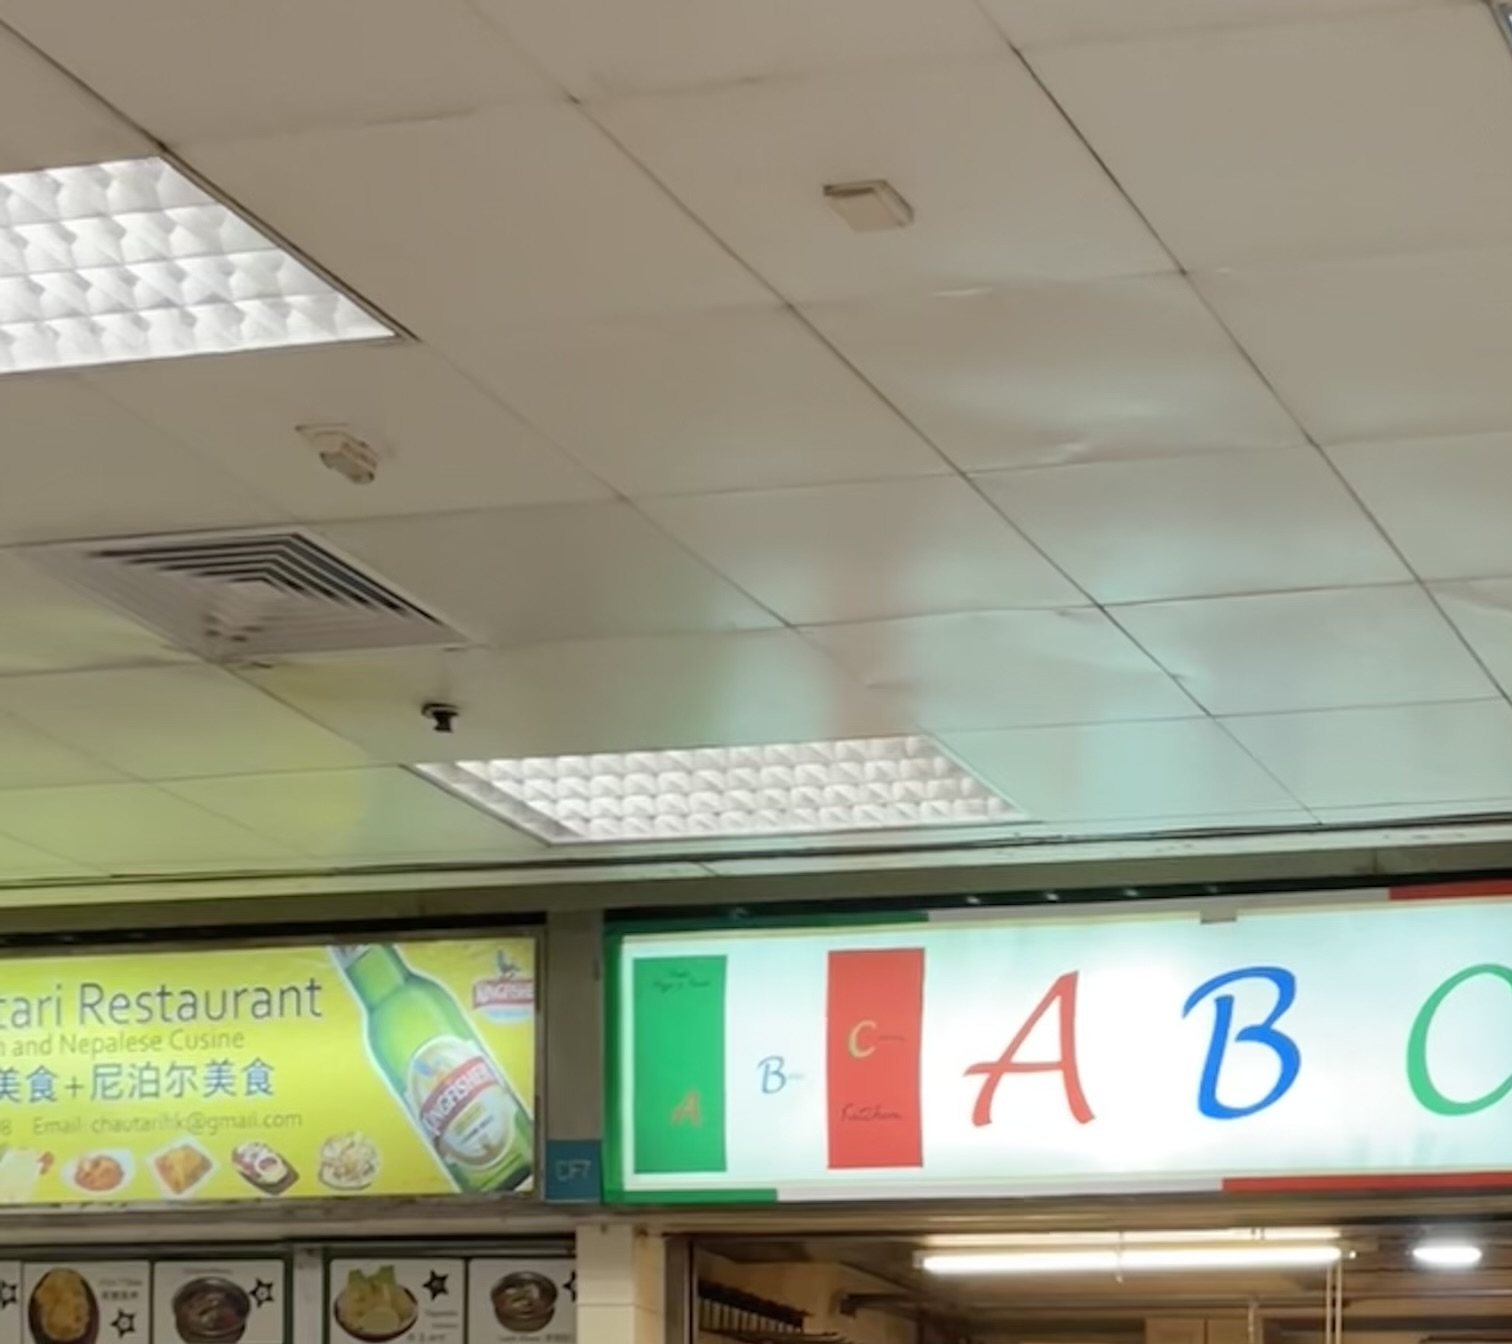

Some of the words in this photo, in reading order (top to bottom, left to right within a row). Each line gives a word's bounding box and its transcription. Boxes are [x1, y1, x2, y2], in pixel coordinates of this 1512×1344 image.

[79, 977, 323, 1025] Restaurant
[12, 1032, 51, 1057] and
[59, 1030, 162, 1060] Nepalese
[168, 1028, 245, 1051] Cusine
[848, 1019, 877, 1059] C
[963, 969, 1095, 1127] A
[1184, 965, 1300, 1120] B
[757, 1055, 787, 1094] B
[555, 1159, 592, 1182] CF7
